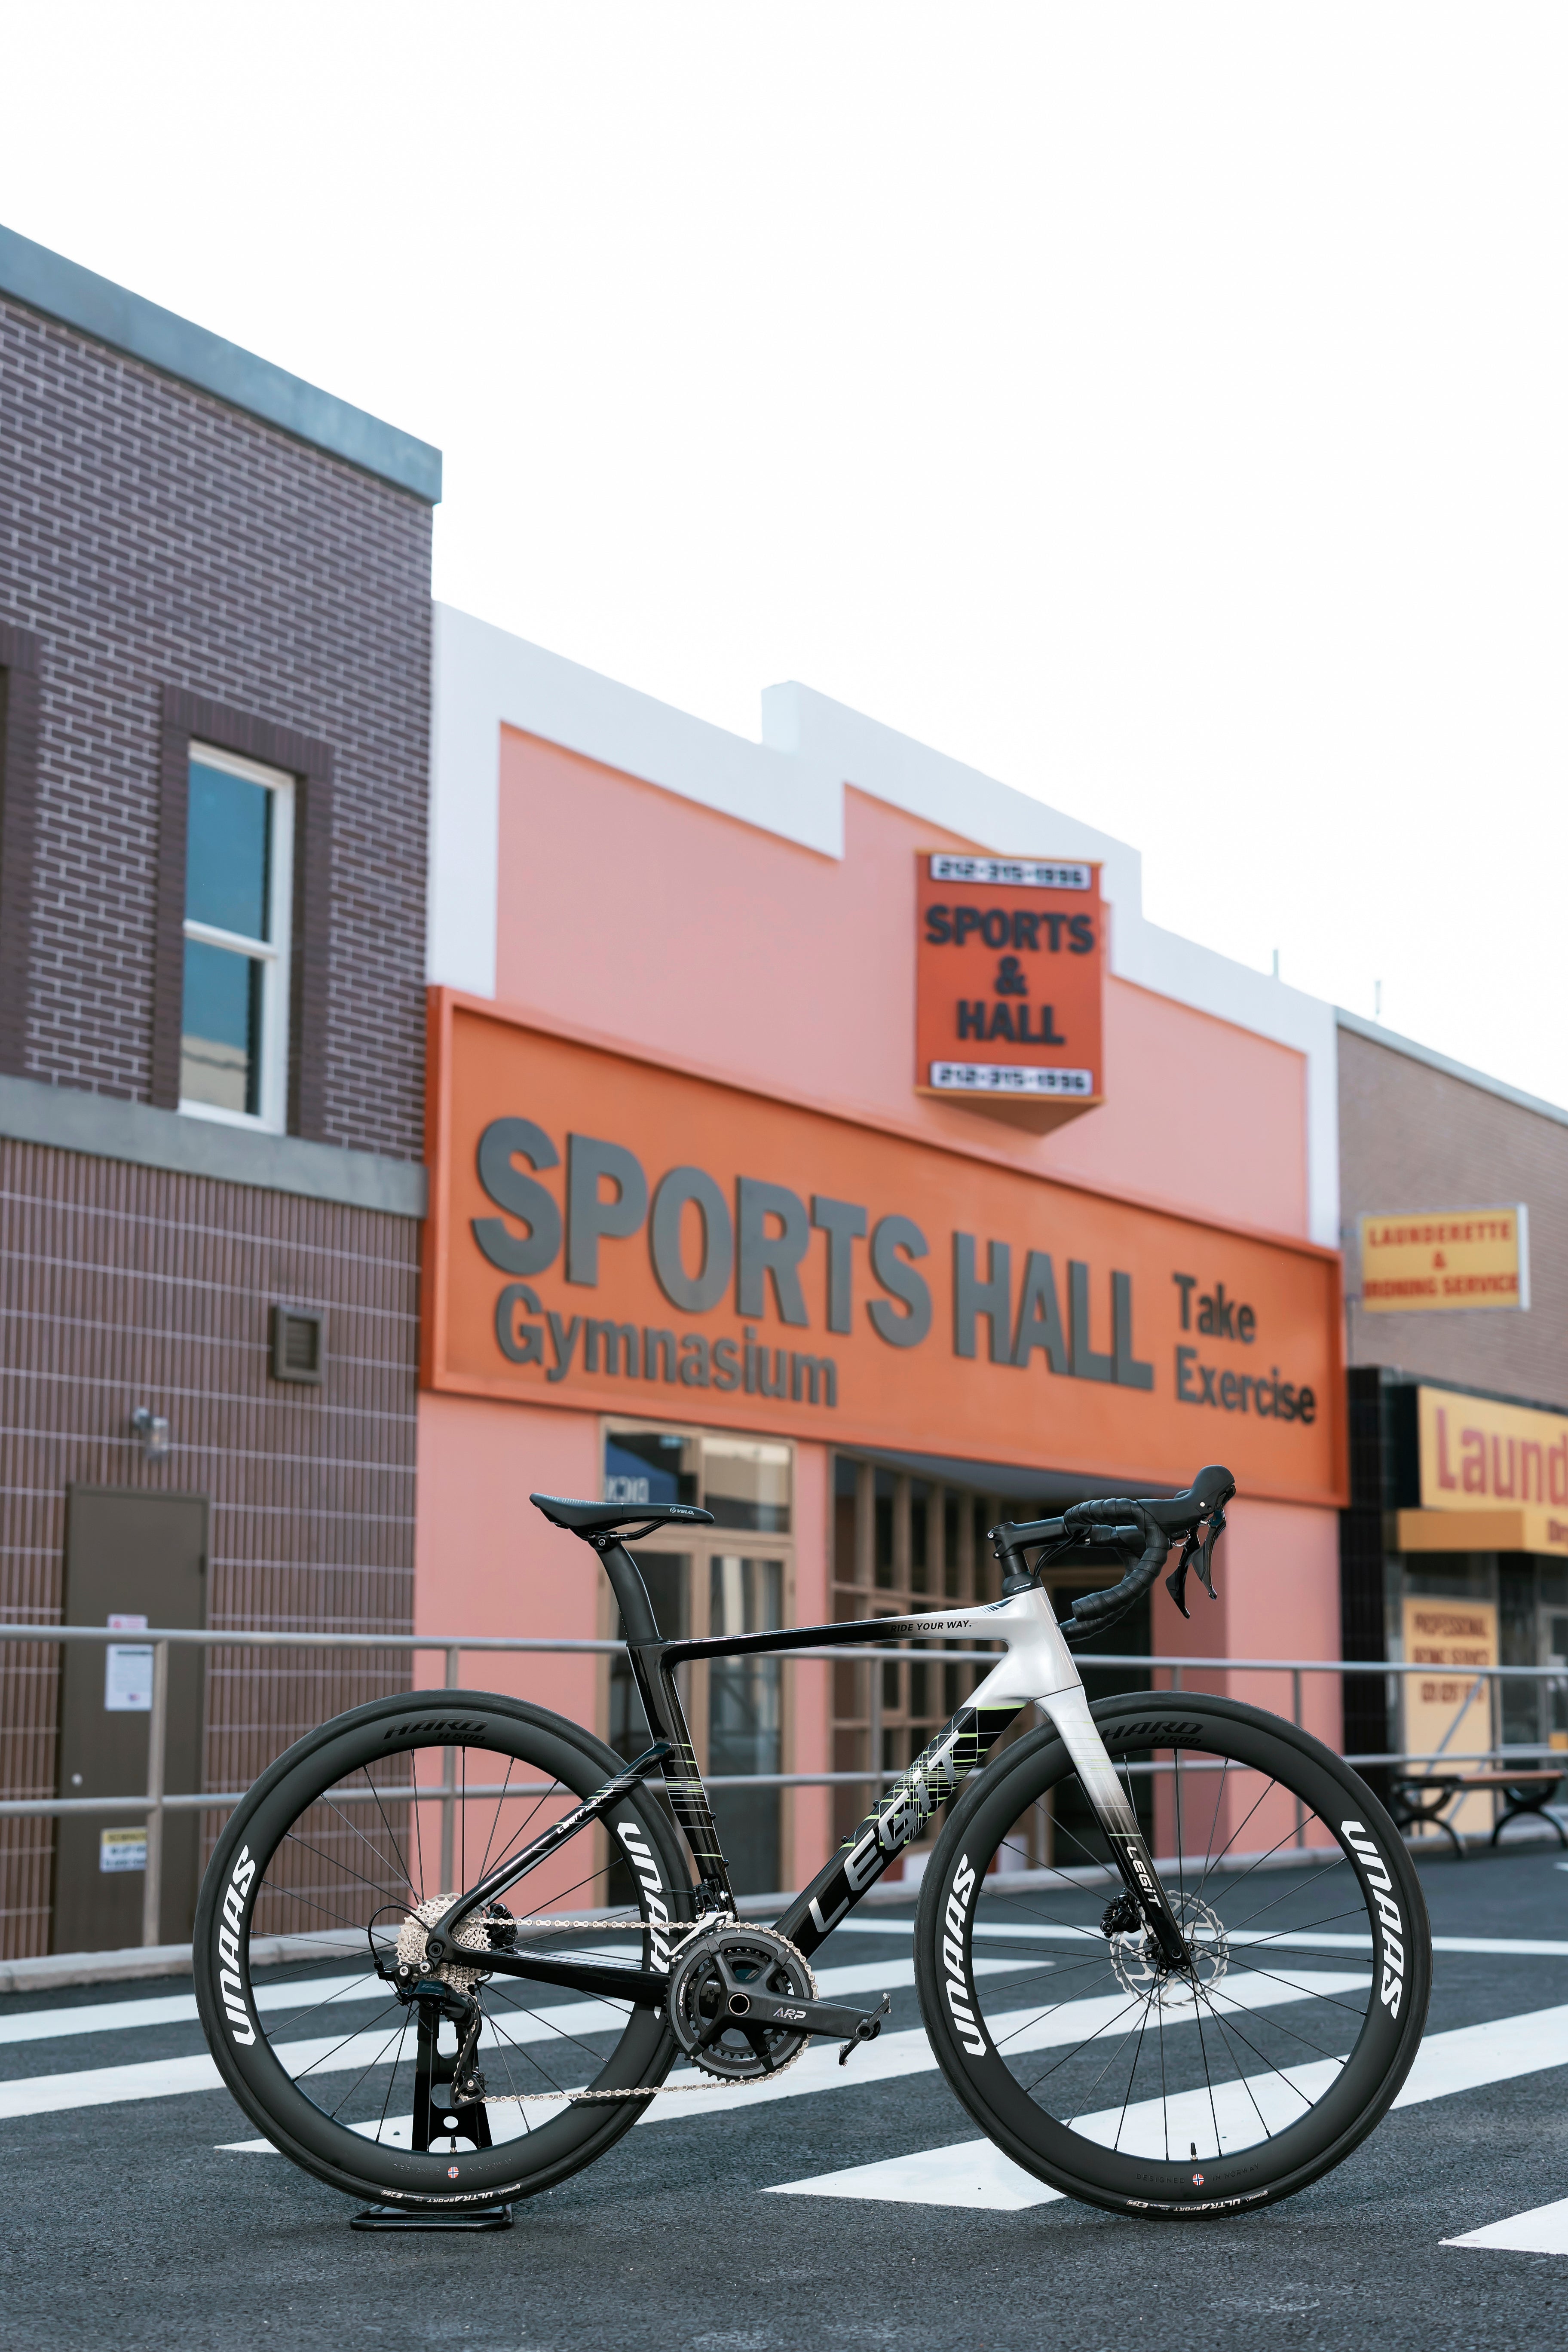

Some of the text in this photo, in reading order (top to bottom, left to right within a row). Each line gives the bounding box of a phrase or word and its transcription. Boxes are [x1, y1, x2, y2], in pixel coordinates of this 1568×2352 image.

[925, 904, 1094, 954] SPORTS
[994, 956, 1028, 996] &
[956, 1000, 1066, 1045] HALL
[1369, 1220, 1511, 1248] LAUNDERETTE
[470, 1116, 1154, 1392] SPORTS HALL
[1173, 1271, 1256, 1344] Take
[494, 1282, 838, 1408] Gymnasium
[1175, 1344, 1315, 1425] Exercise
[891, 1620, 972, 1632] RIDE YOUR WAY.
[383, 1718, 488, 1740] HARD
[1100, 1721, 1204, 1742] HARD
[772, 2007, 806, 2020] ARP
[392, 2164, 440, 2176] DESIGNED
[478, 2158, 514, 2171] NORWAY
[1224, 2163, 1259, 2178] NORWAY
[1136, 2173, 1185, 2184] DESIGNED
